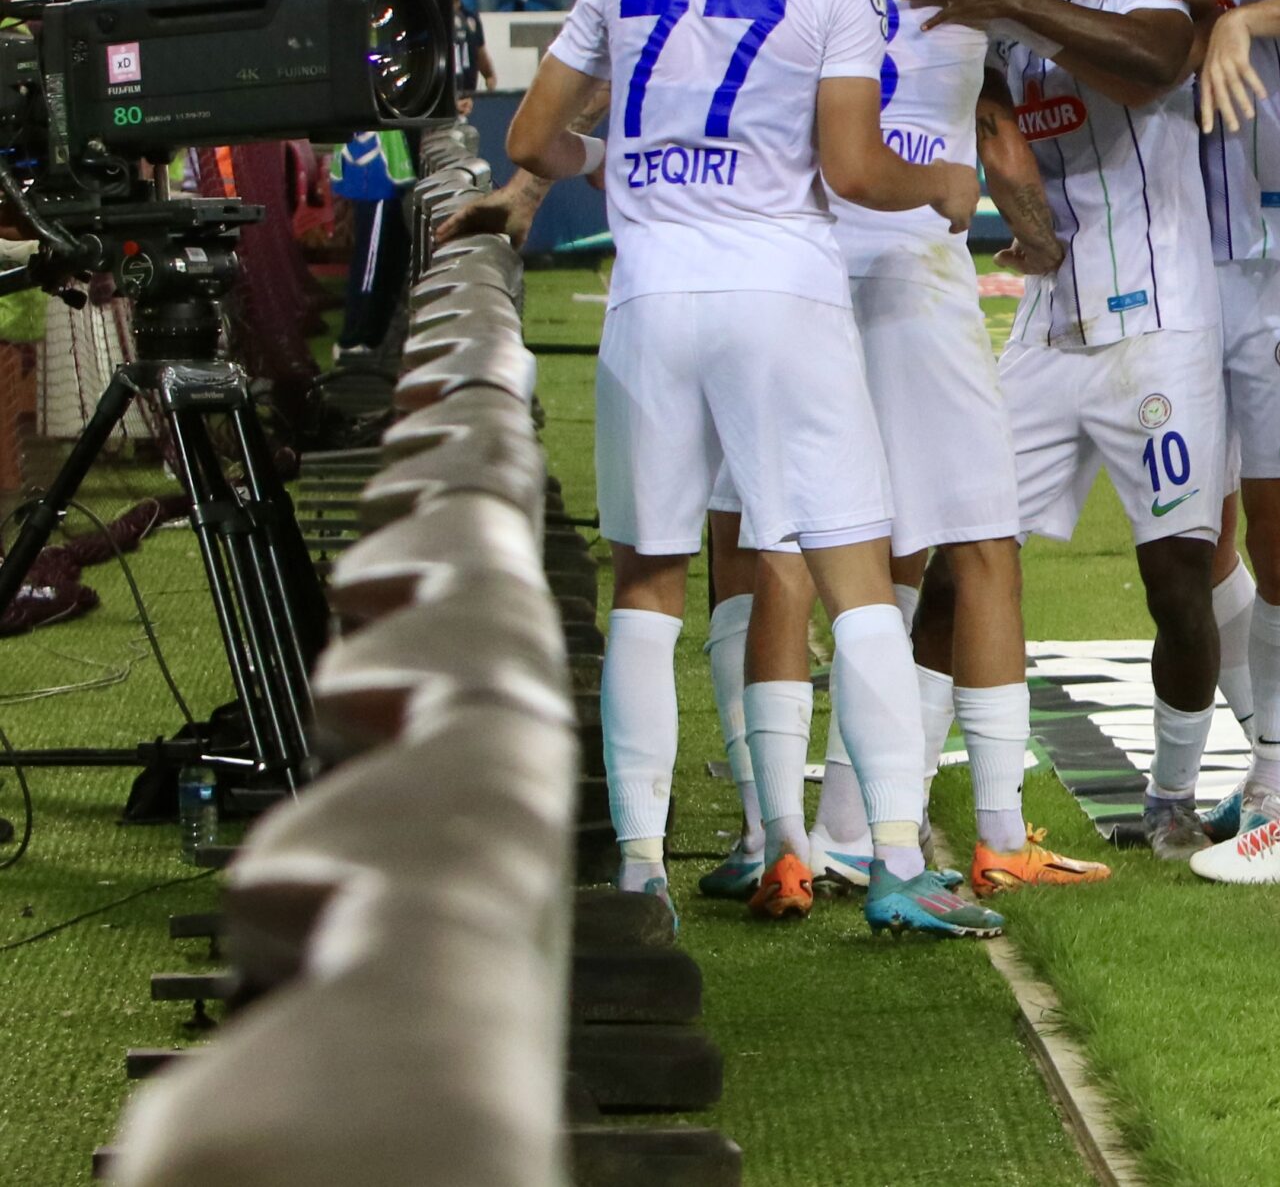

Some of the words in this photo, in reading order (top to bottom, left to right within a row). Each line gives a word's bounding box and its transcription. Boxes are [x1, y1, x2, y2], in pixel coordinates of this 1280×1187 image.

[114, 106, 142, 125] 80
[624, 145, 738, 188] ZEQIRI
[1143, 431, 1190, 492] 10
